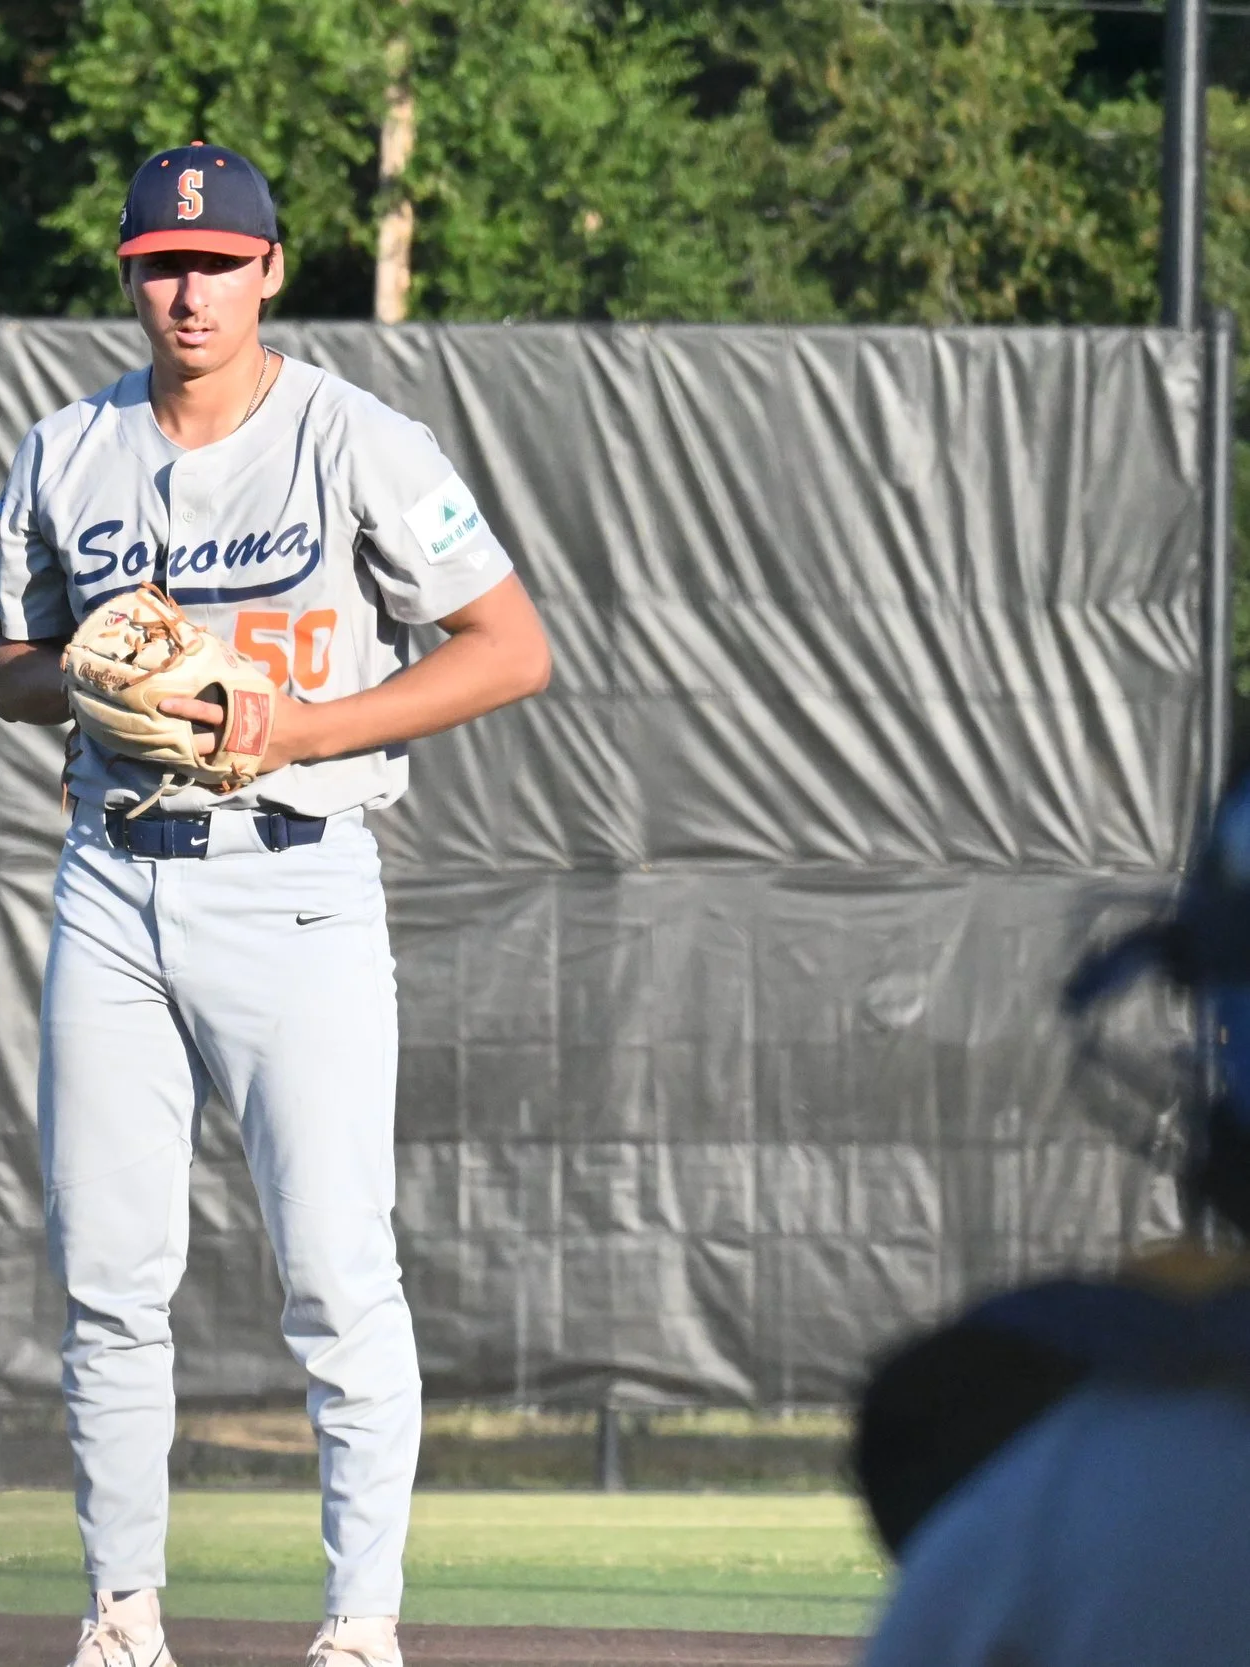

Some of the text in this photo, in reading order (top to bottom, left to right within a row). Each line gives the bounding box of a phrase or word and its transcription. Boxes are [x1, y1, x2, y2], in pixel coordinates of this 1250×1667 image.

[177, 168, 204, 221] S
[74, 520, 320, 600] Sonoma
[431, 533, 455, 554] Bank
[235, 609, 337, 690] 50
